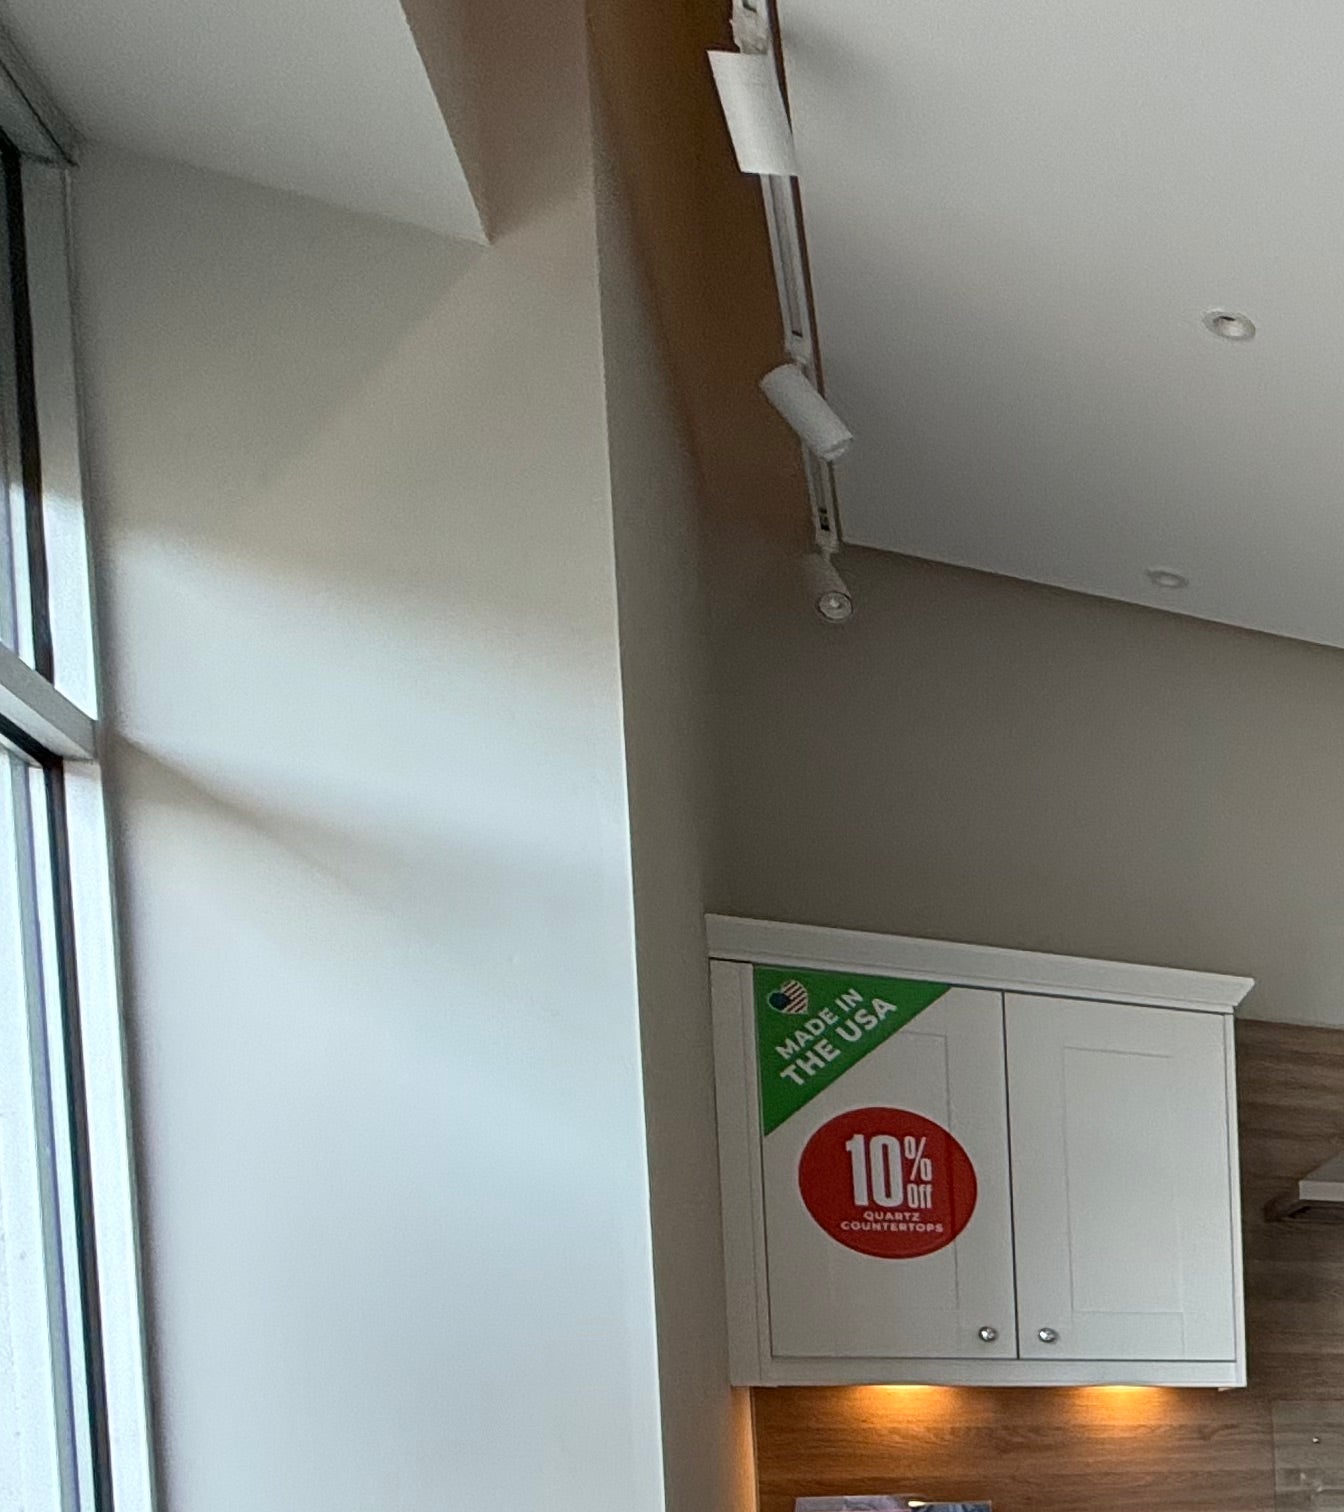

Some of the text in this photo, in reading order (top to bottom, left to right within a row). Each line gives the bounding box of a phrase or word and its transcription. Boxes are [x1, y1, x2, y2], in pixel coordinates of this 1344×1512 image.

[775, 988, 864, 1060] MADE IN
[780, 997, 898, 1086] THE USA
[840, 1220, 944, 1234] COUNTERTOPS
[863, 1211, 921, 1222] QUARTZ
